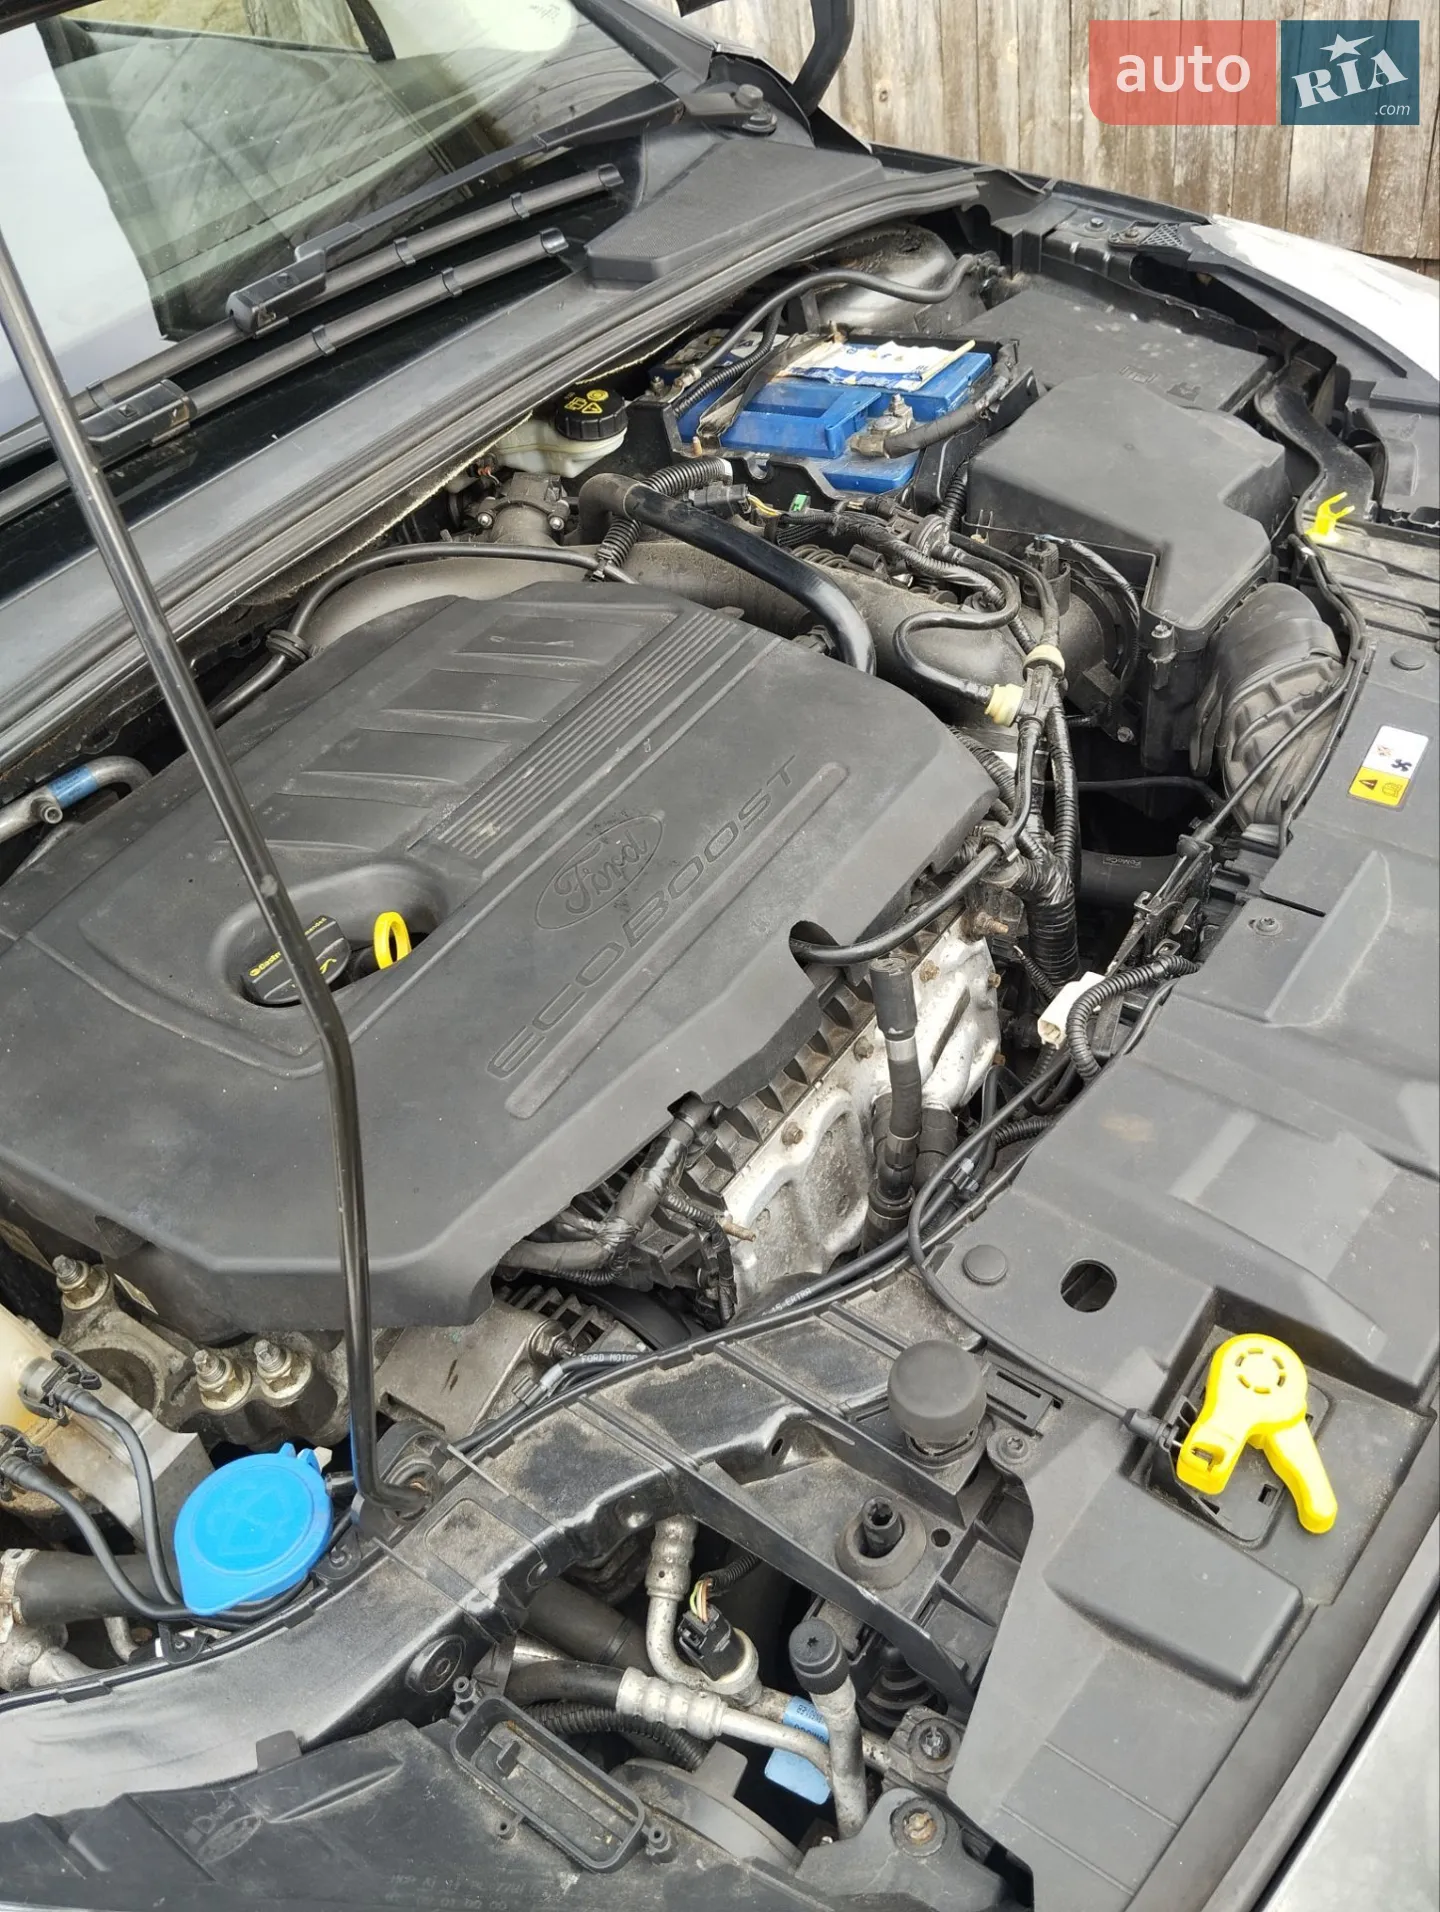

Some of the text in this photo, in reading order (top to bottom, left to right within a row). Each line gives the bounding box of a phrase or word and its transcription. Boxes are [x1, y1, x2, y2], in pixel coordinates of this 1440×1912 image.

[554, 829, 649, 914] Ford
[486, 753, 796, 1080] ECOBOOST
[259, 951, 282, 970] Castr
[581, 1353, 605, 1364] FORD
